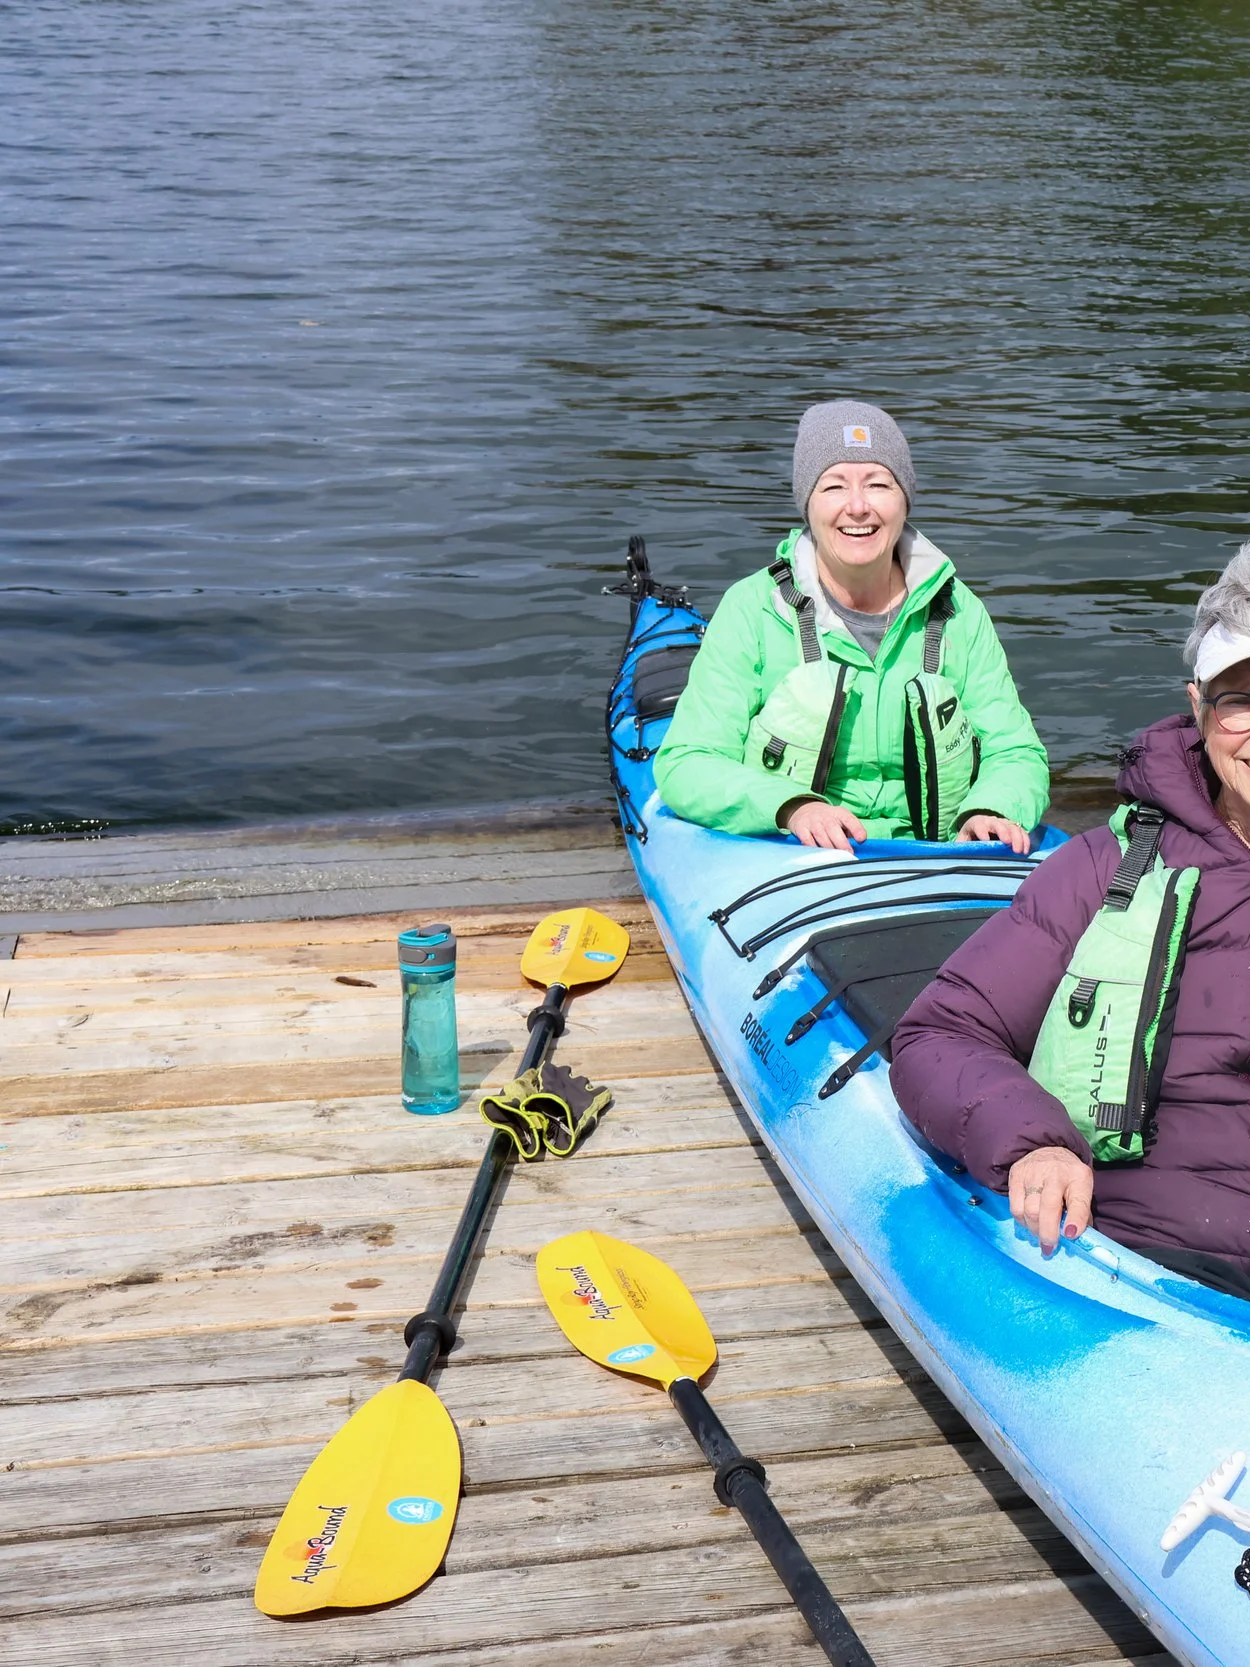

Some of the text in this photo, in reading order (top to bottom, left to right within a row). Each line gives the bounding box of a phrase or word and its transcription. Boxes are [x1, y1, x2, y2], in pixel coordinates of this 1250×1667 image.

[1088, 1037, 1108, 1118] SALUS
[555, 1265, 622, 1320] Aqua-Bound
[291, 1504, 349, 1584] Aqua-Bound
